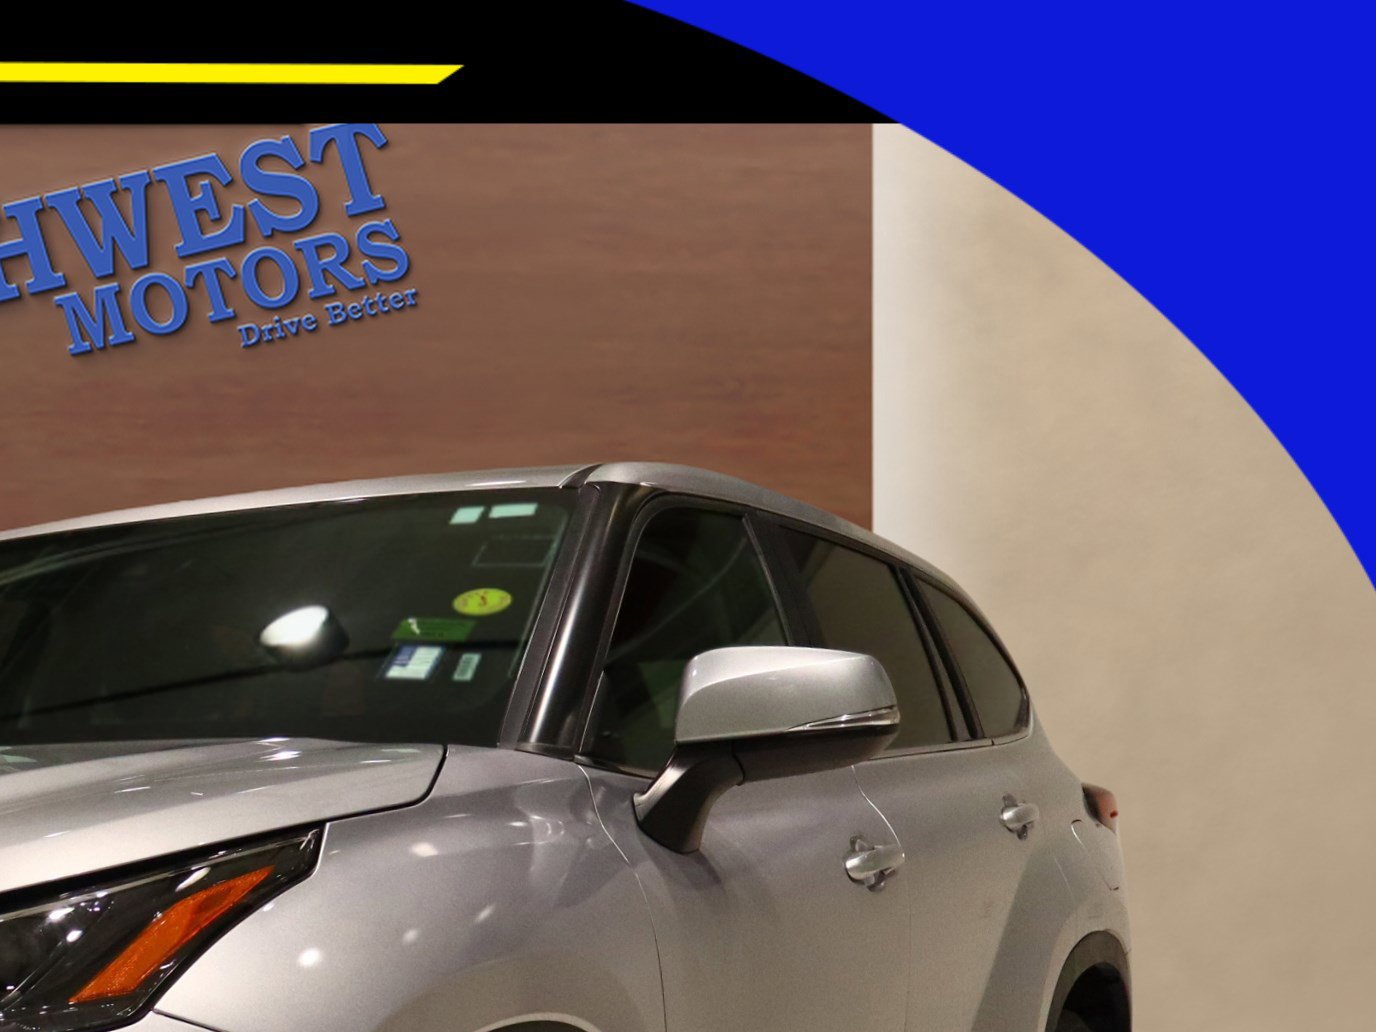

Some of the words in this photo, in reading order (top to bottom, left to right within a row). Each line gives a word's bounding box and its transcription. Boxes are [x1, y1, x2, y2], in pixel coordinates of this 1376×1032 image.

[53, 218, 410, 356] MOTORS
[238, 314, 318, 348] Drive
[325, 289, 418, 326] Better
